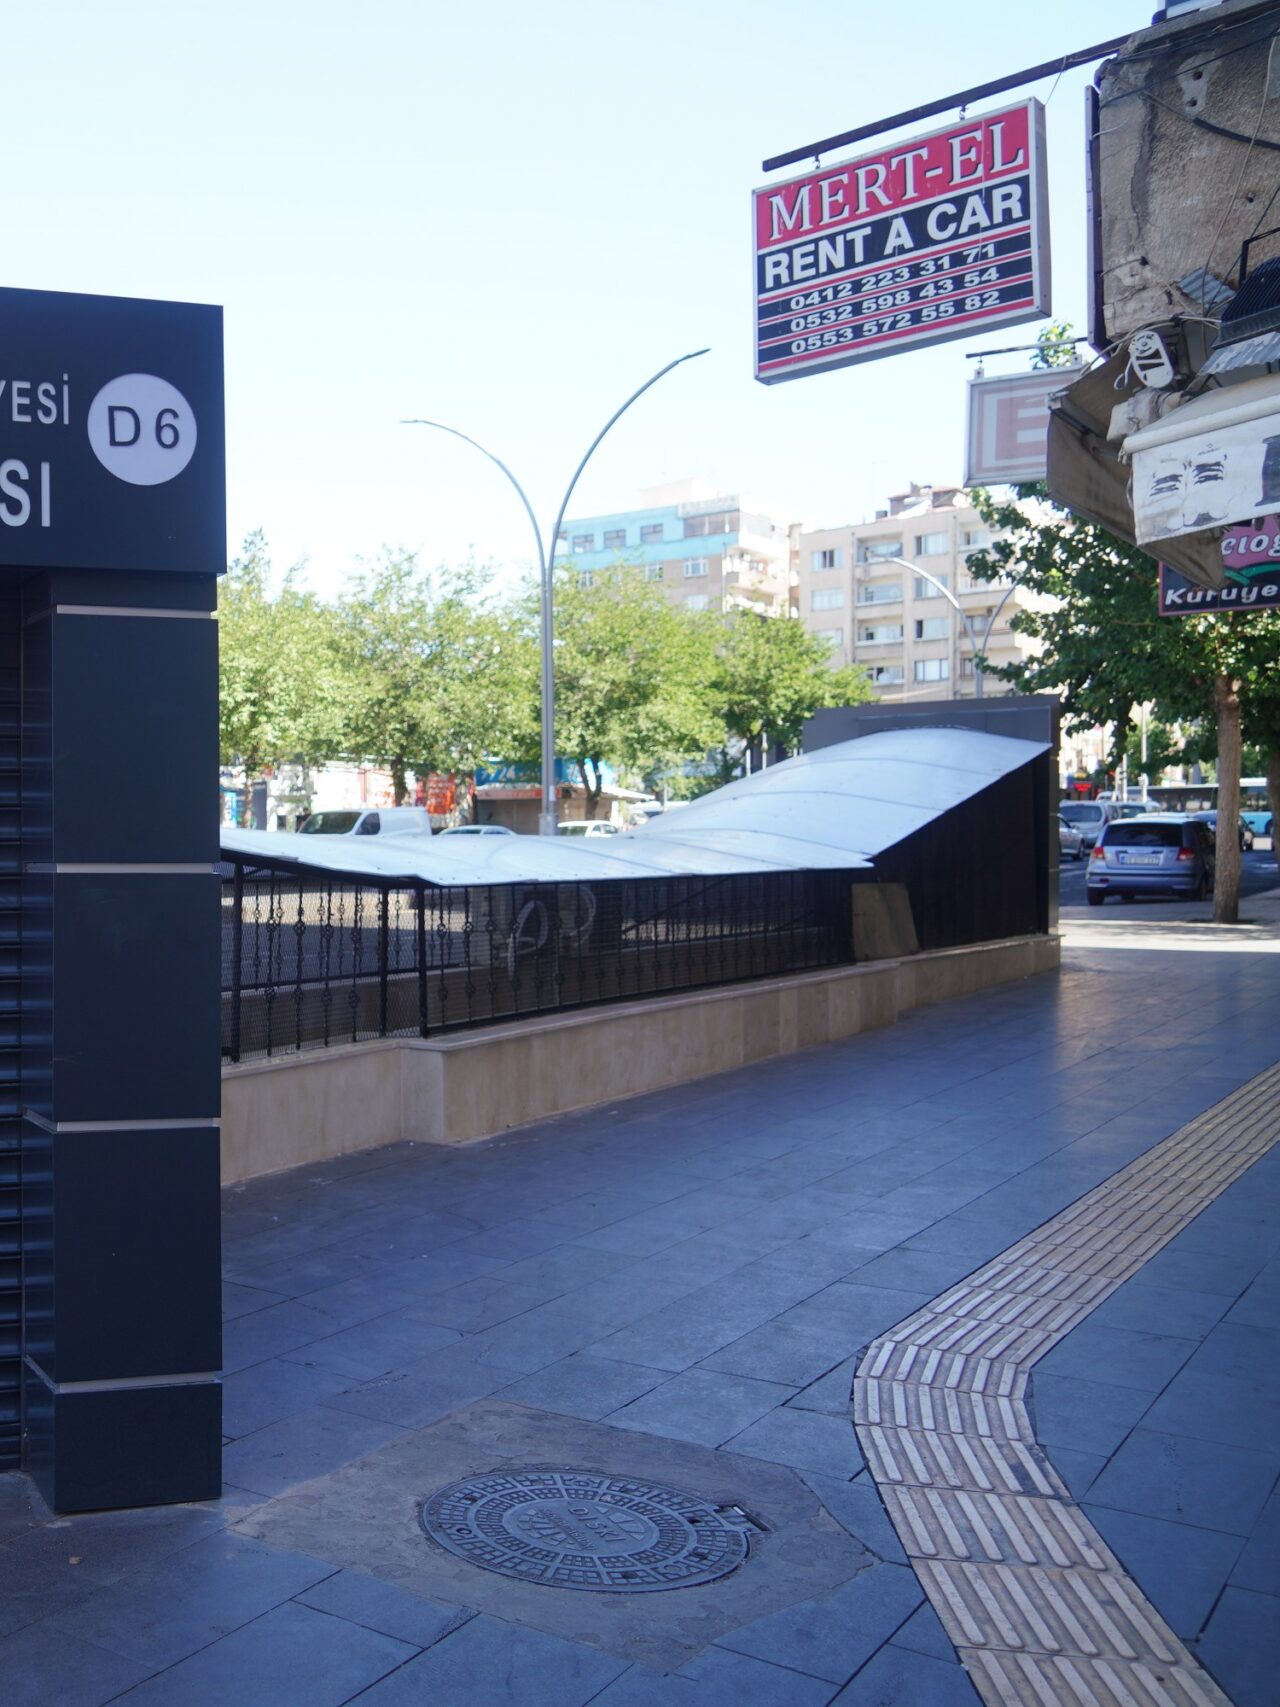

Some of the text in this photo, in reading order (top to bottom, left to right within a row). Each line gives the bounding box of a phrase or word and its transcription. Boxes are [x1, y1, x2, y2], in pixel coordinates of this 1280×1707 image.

[768, 122, 1024, 240] MERT-EL
[765, 184, 1023, 288] RENT A CAR
[790, 243, 995, 311] 0412 223 31 71
[790, 266, 999, 332] 0532 598 43 54
[791, 290, 999, 354] 0553 572 55 82
